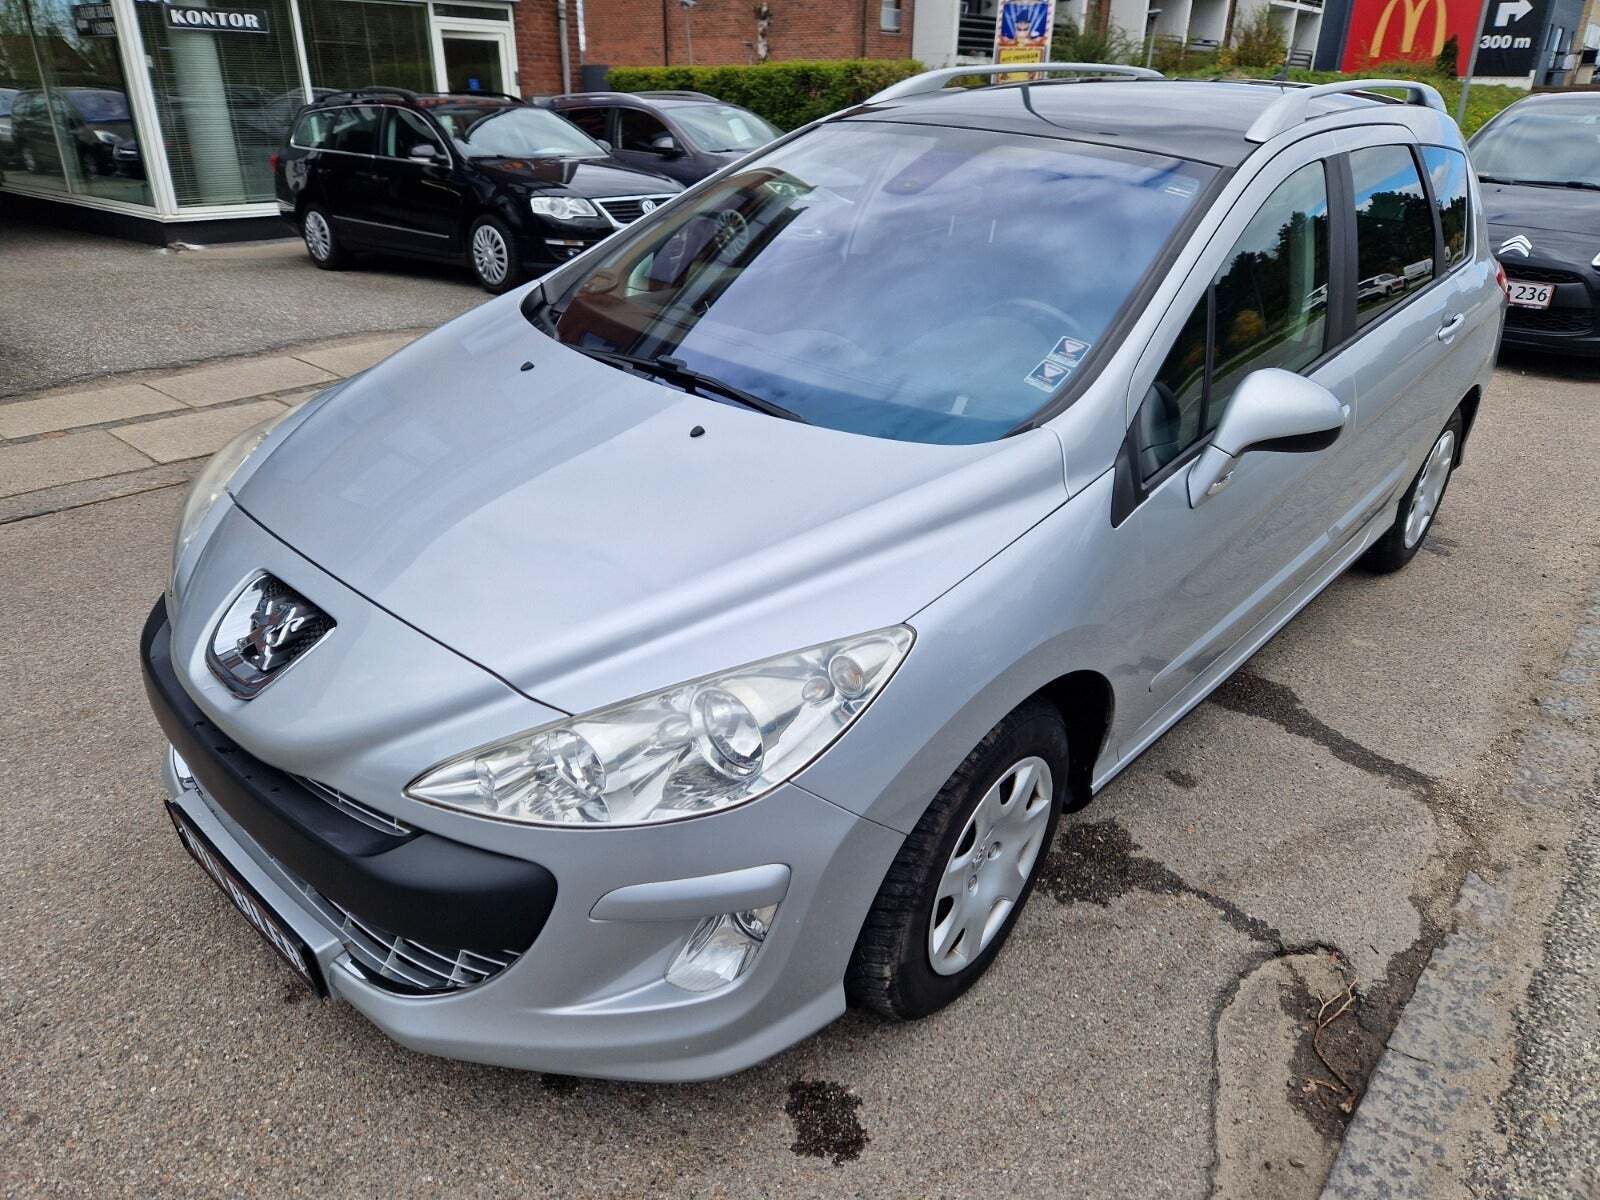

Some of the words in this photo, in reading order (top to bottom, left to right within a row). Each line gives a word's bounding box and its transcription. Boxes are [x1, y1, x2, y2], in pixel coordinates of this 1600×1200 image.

[170, 9, 259, 28] KONTOR
[1479, 34, 1512, 49] 300
[1513, 37, 1531, 49] m
[1515, 286, 1548, 302] 236
